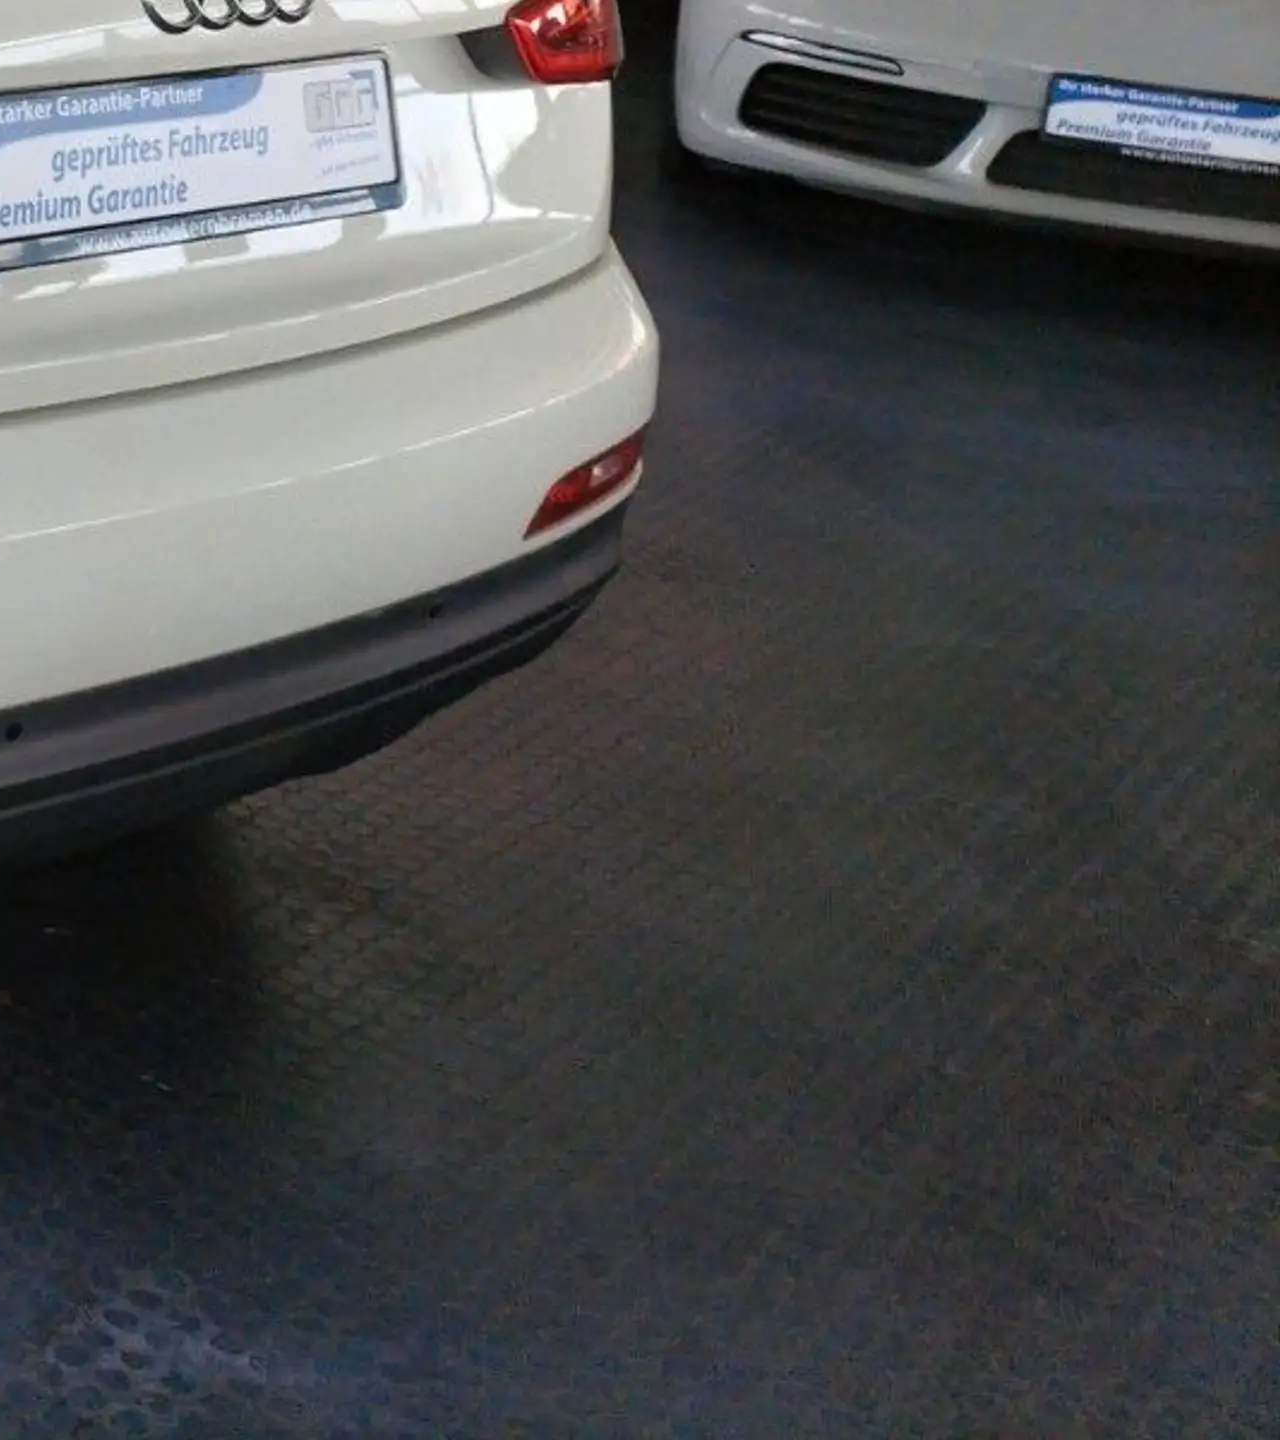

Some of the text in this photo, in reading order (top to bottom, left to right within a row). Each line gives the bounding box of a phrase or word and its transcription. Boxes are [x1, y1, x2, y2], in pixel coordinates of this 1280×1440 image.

[56, 85, 204, 118] Garantie-Partner
[51, 134, 163, 182] geprüftes
[168, 123, 269, 159] Fahrzeug
[87, 176, 188, 215] Garantie
